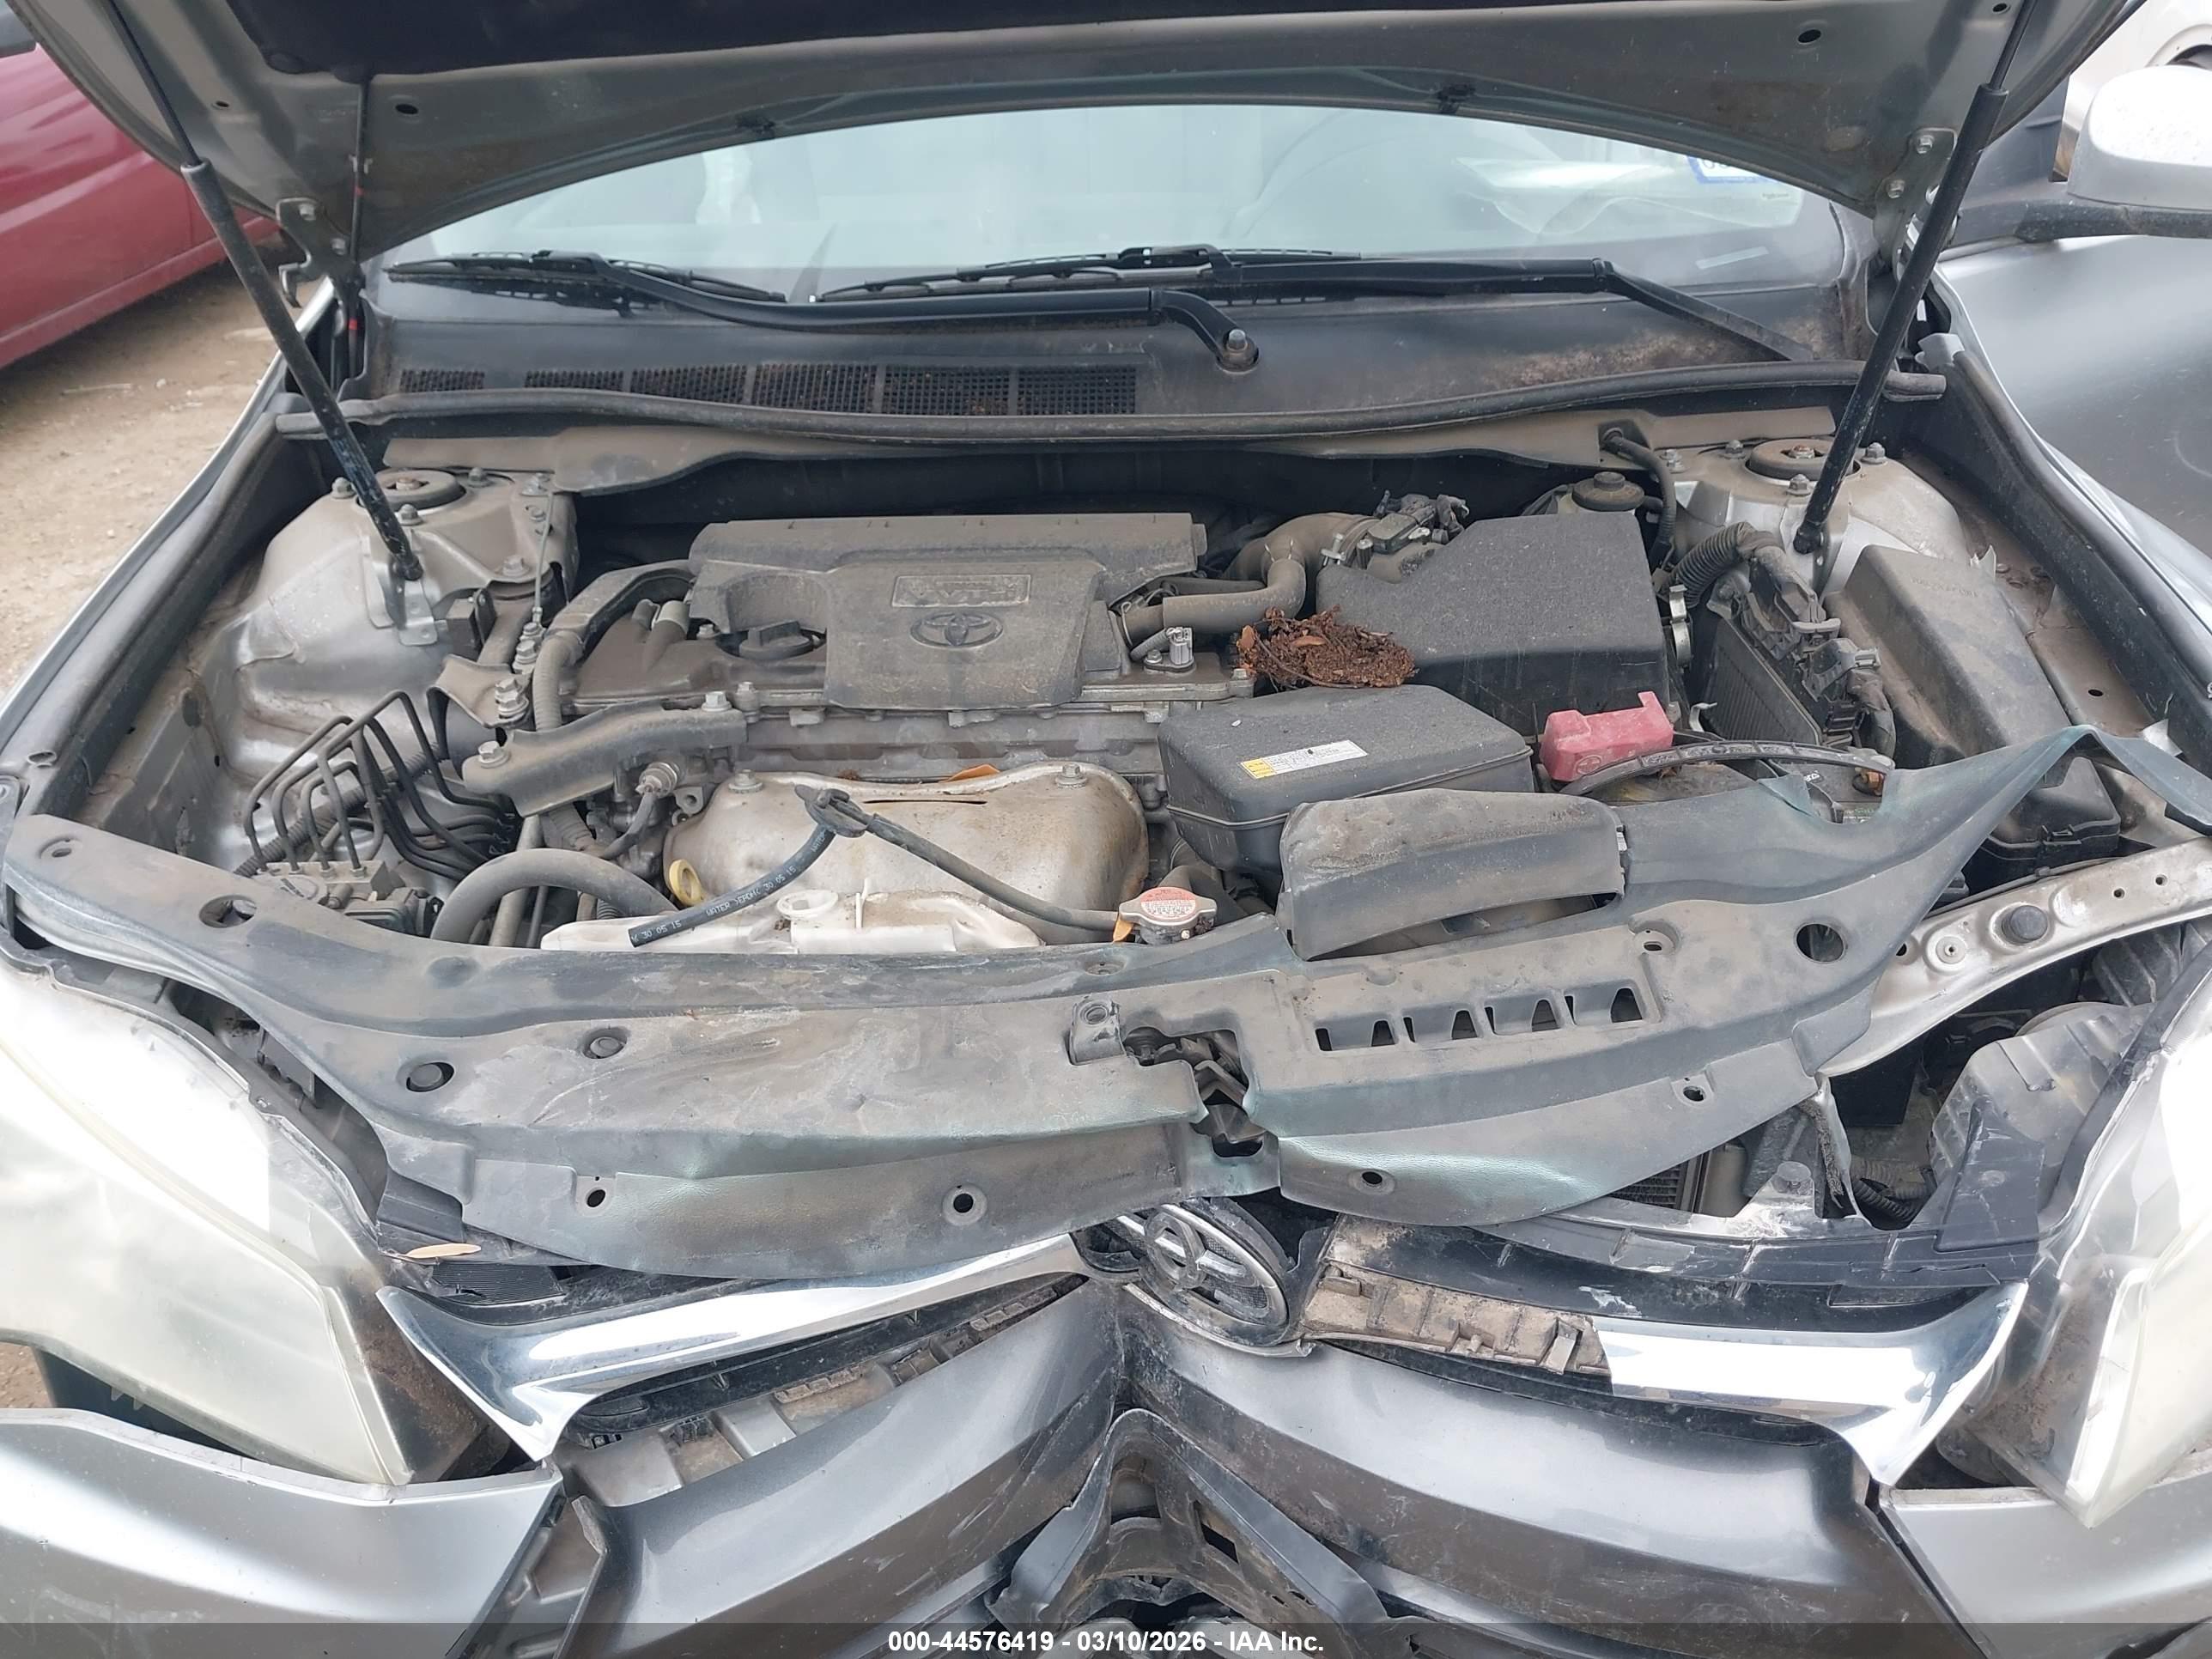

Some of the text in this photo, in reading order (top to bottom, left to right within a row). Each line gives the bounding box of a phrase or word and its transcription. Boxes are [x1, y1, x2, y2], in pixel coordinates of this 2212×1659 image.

[641, 926, 653, 939] 30
[656, 924, 667, 935] 05
[672, 919, 683, 930] 15
[706, 902, 731, 917] WATER
[763, 881, 774, 892] 30
[775, 873, 786, 884] 05
[787, 865, 797, 877] 15
